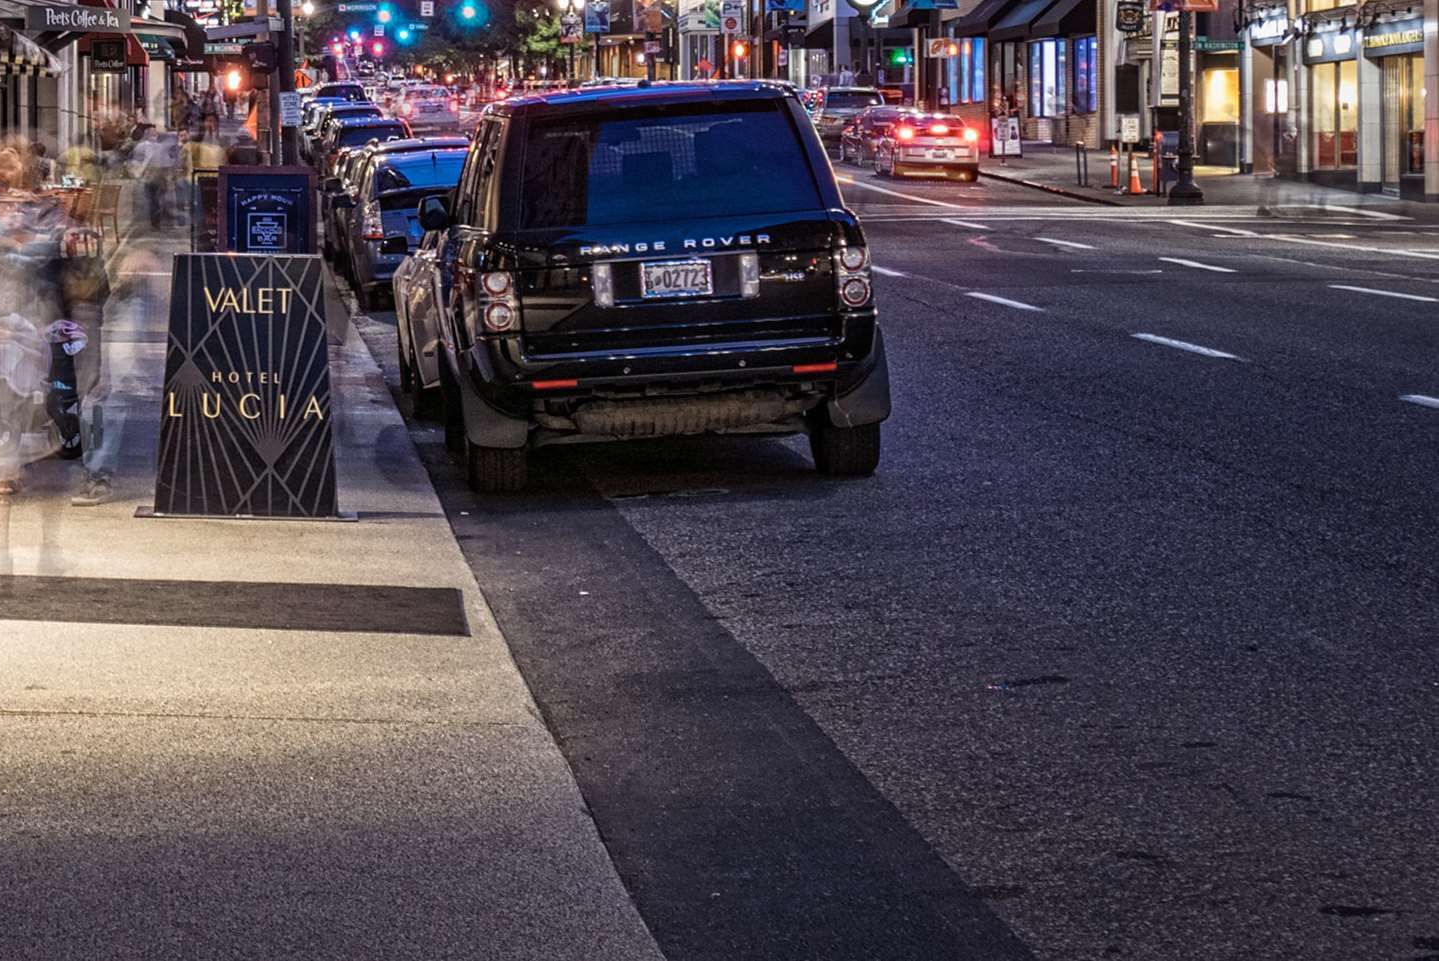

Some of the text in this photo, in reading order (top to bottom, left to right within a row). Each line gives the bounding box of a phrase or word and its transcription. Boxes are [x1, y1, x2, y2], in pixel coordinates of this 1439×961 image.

[70, 9, 98, 28] Coffee
[98, 15, 105, 25] &
[104, 10, 119, 28] Tea
[240, 194, 268, 207] HAPPY
[580, 234, 771, 256] RANGE ROVER
[785, 272, 806, 281] HSE
[204, 287, 292, 315] VALET
[212, 371, 281, 385] HOTEL
[167, 392, 324, 420] LUCIA
